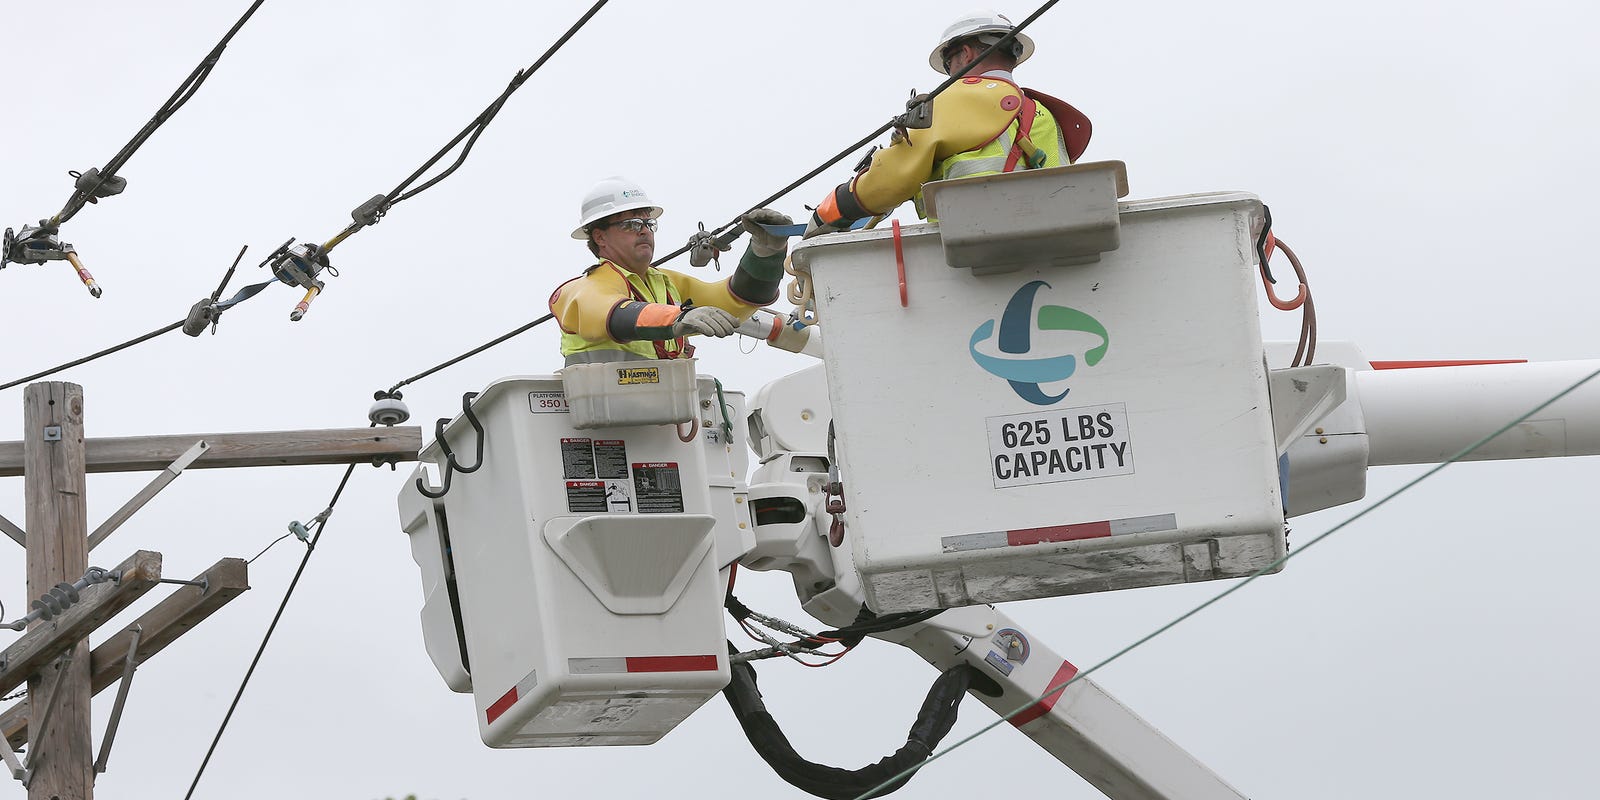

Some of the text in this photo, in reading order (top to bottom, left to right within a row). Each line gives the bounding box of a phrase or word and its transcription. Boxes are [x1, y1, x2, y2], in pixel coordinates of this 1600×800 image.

[540, 400, 570, 408] 350 L
[1002, 412, 1114, 448] 625 LBS
[994, 441, 1127, 480] CAPACITY
